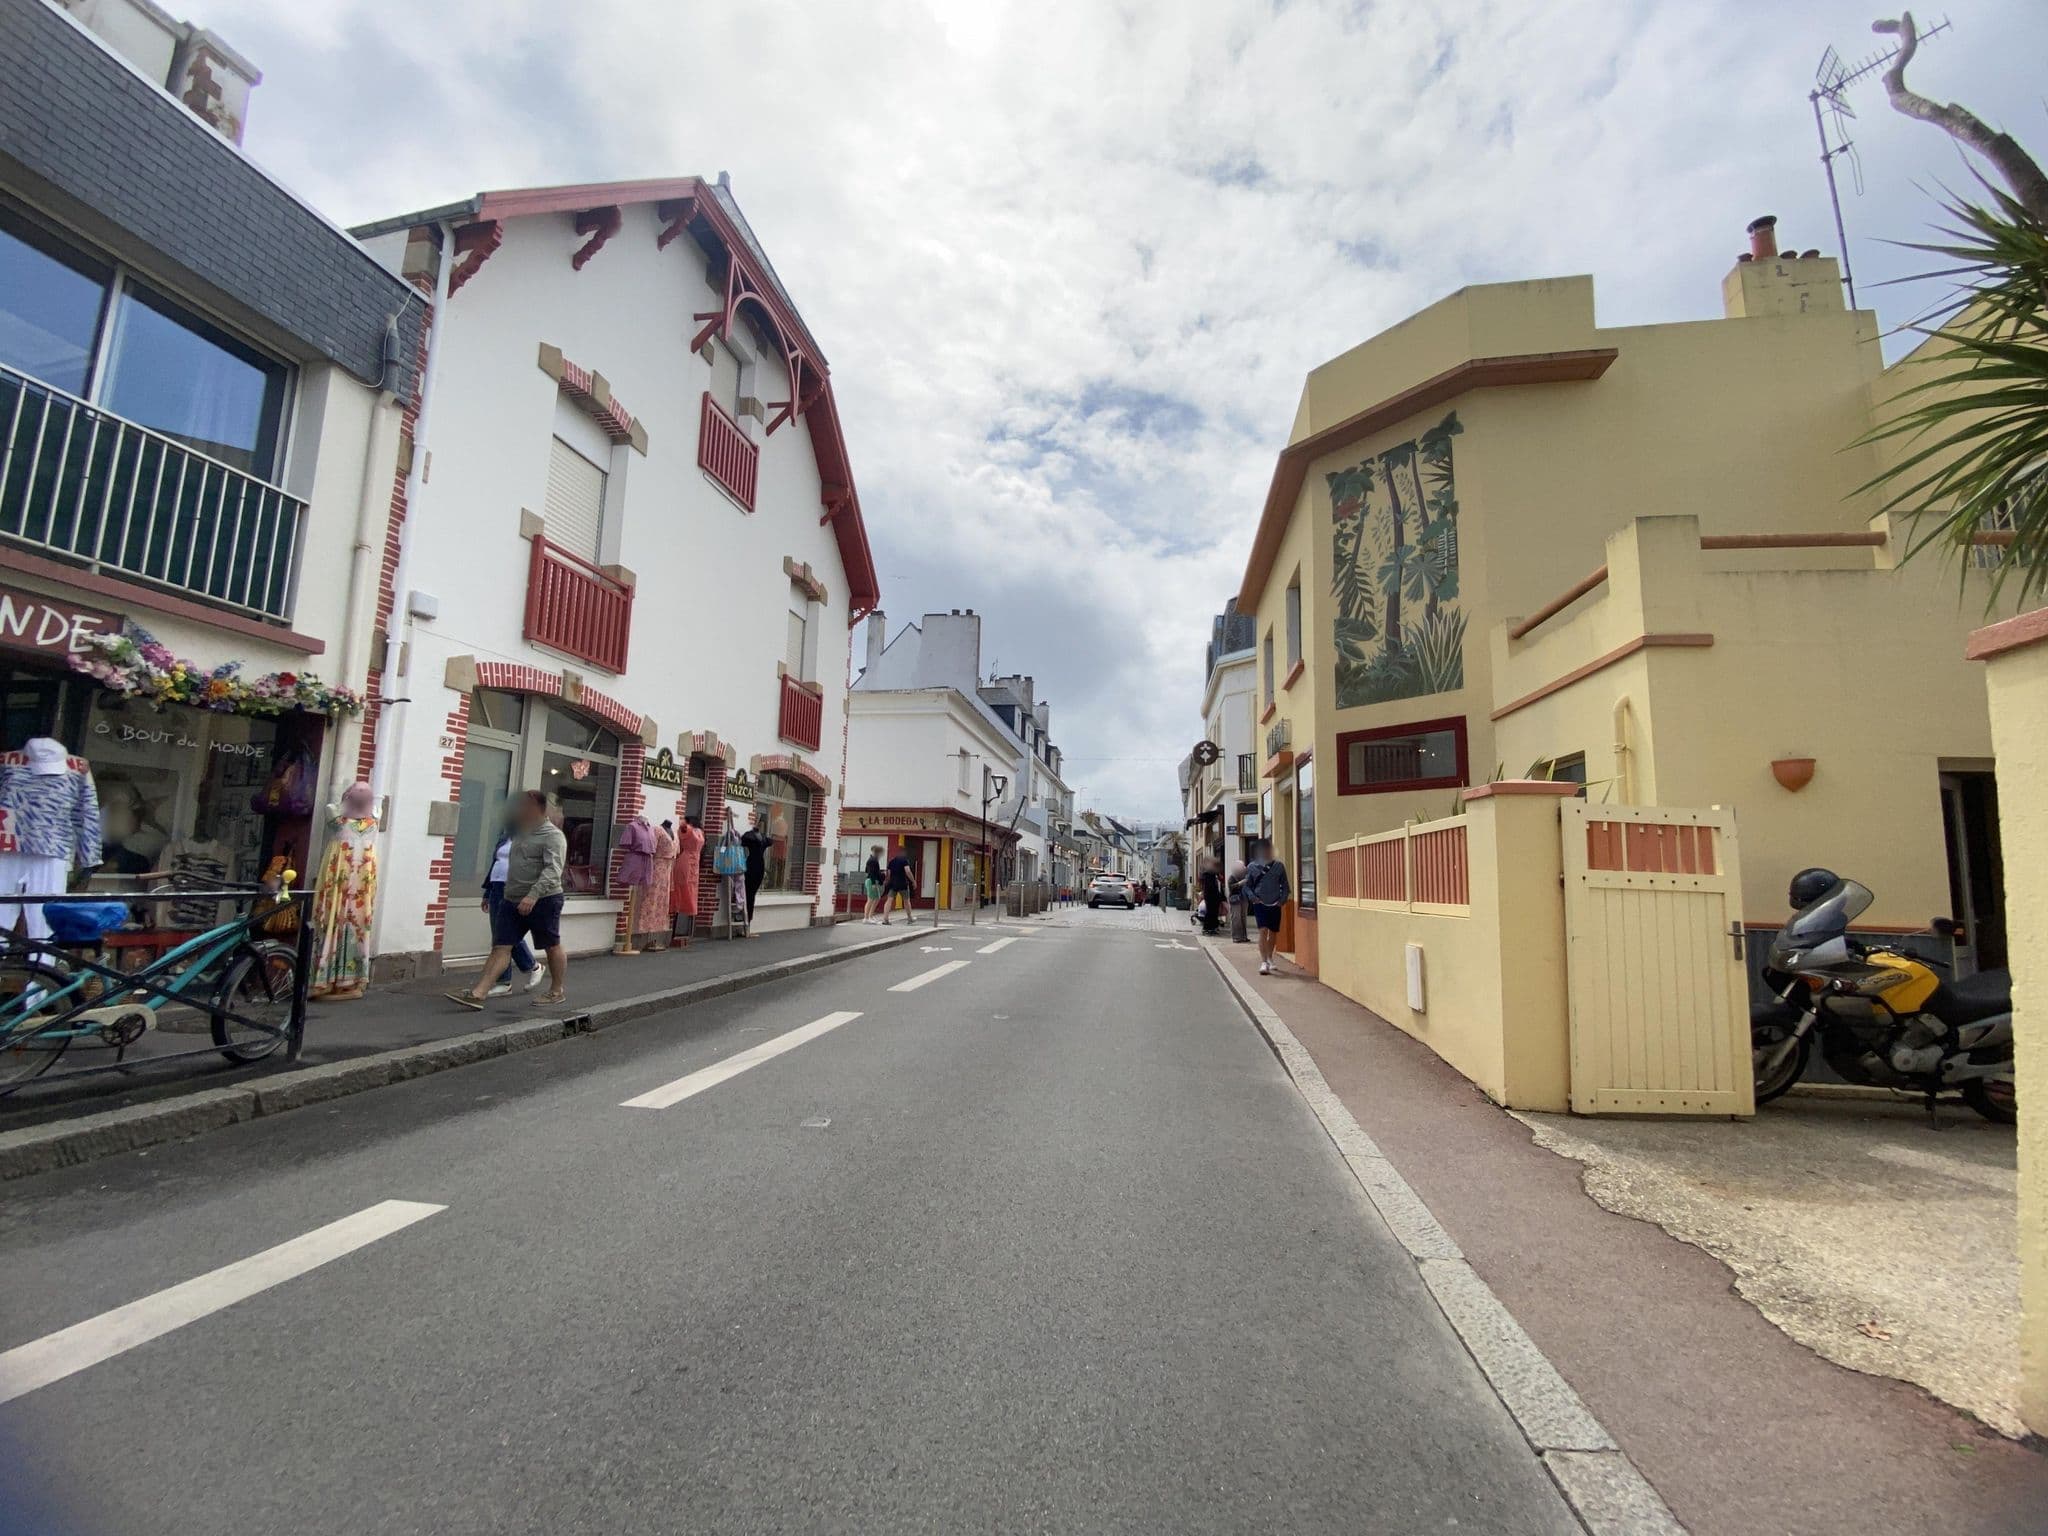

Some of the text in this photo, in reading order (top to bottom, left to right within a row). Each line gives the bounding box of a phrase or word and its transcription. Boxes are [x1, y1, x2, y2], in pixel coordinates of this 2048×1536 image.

[122, 724, 174, 743] BOUT
[177, 733, 200, 747] du
[209, 740, 265, 758] MONDE
[441, 737, 454, 747] 27
[646, 765, 681, 784] NAZCA
[727, 782, 753, 799] NAZCA
[868, 815, 919, 826] LA BODEGA
